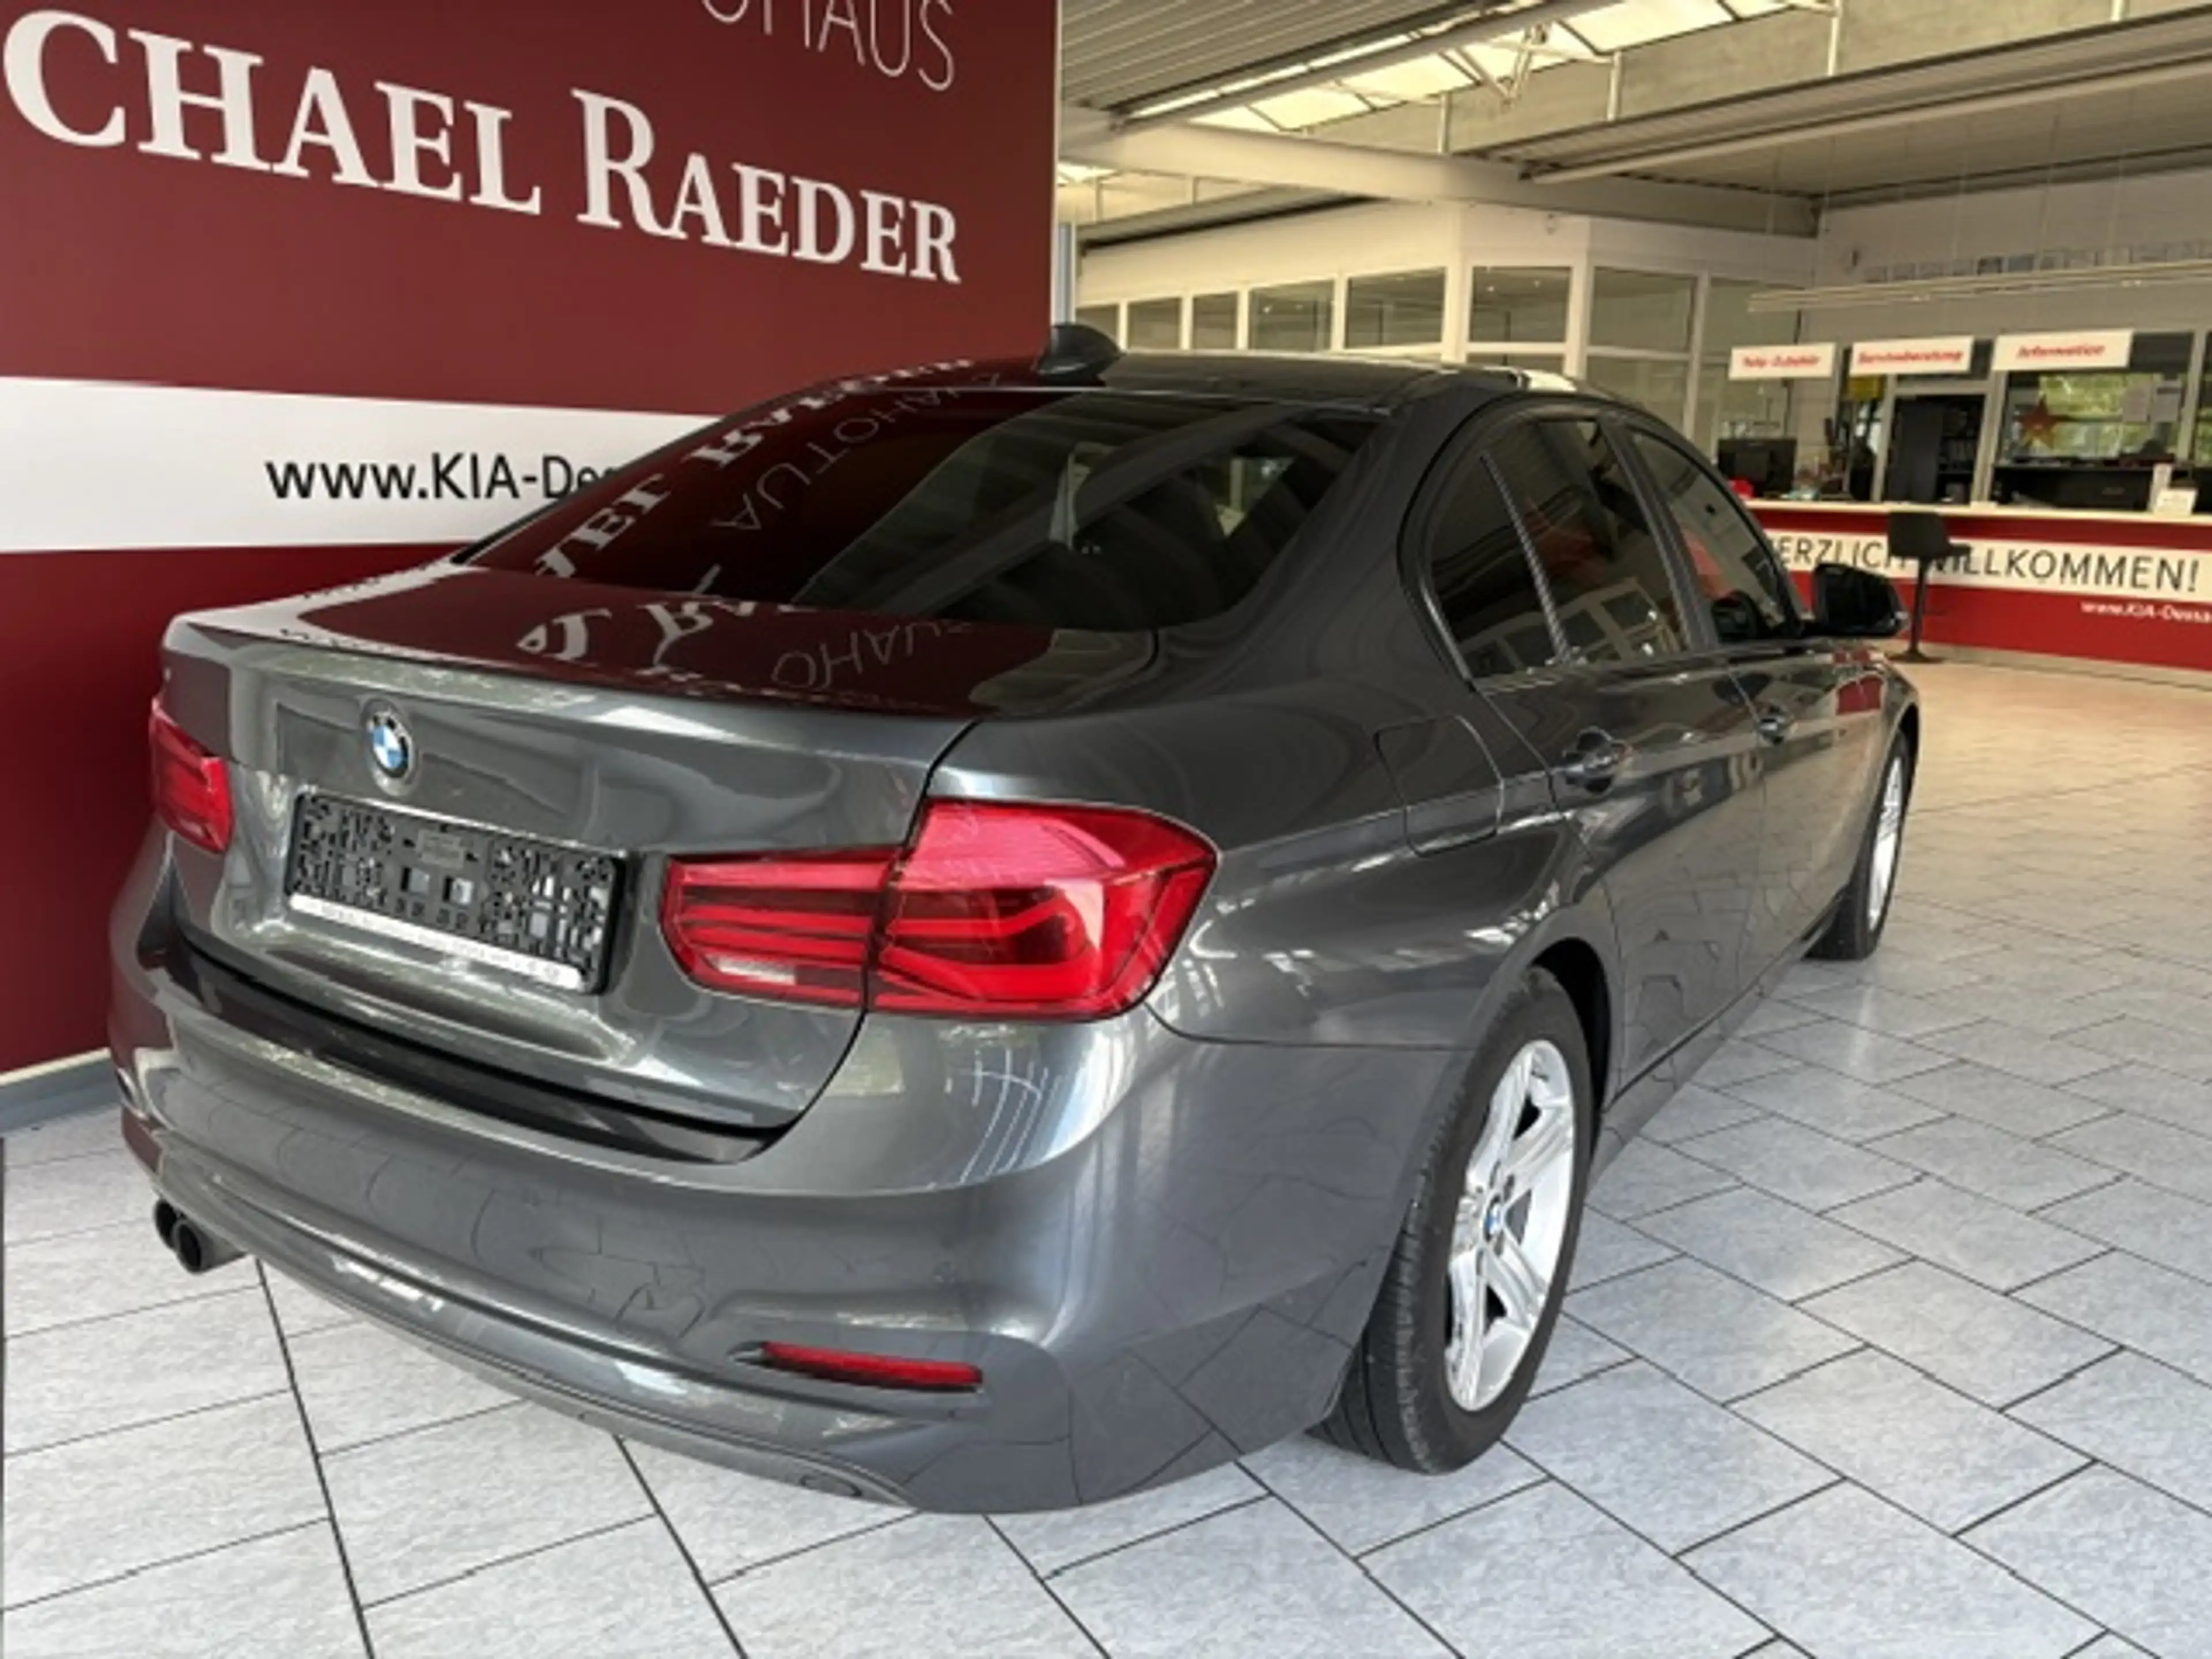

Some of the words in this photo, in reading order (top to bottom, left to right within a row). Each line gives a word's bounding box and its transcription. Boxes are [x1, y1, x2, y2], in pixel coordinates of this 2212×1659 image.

[702, 0, 955, 92] AUS
[3, 9, 541, 215] CHAEL
[571, 88, 961, 284] RAEDER
[266, 453, 613, 500] www.KIA-De
[1767, 535, 1905, 569] ERZLIC
